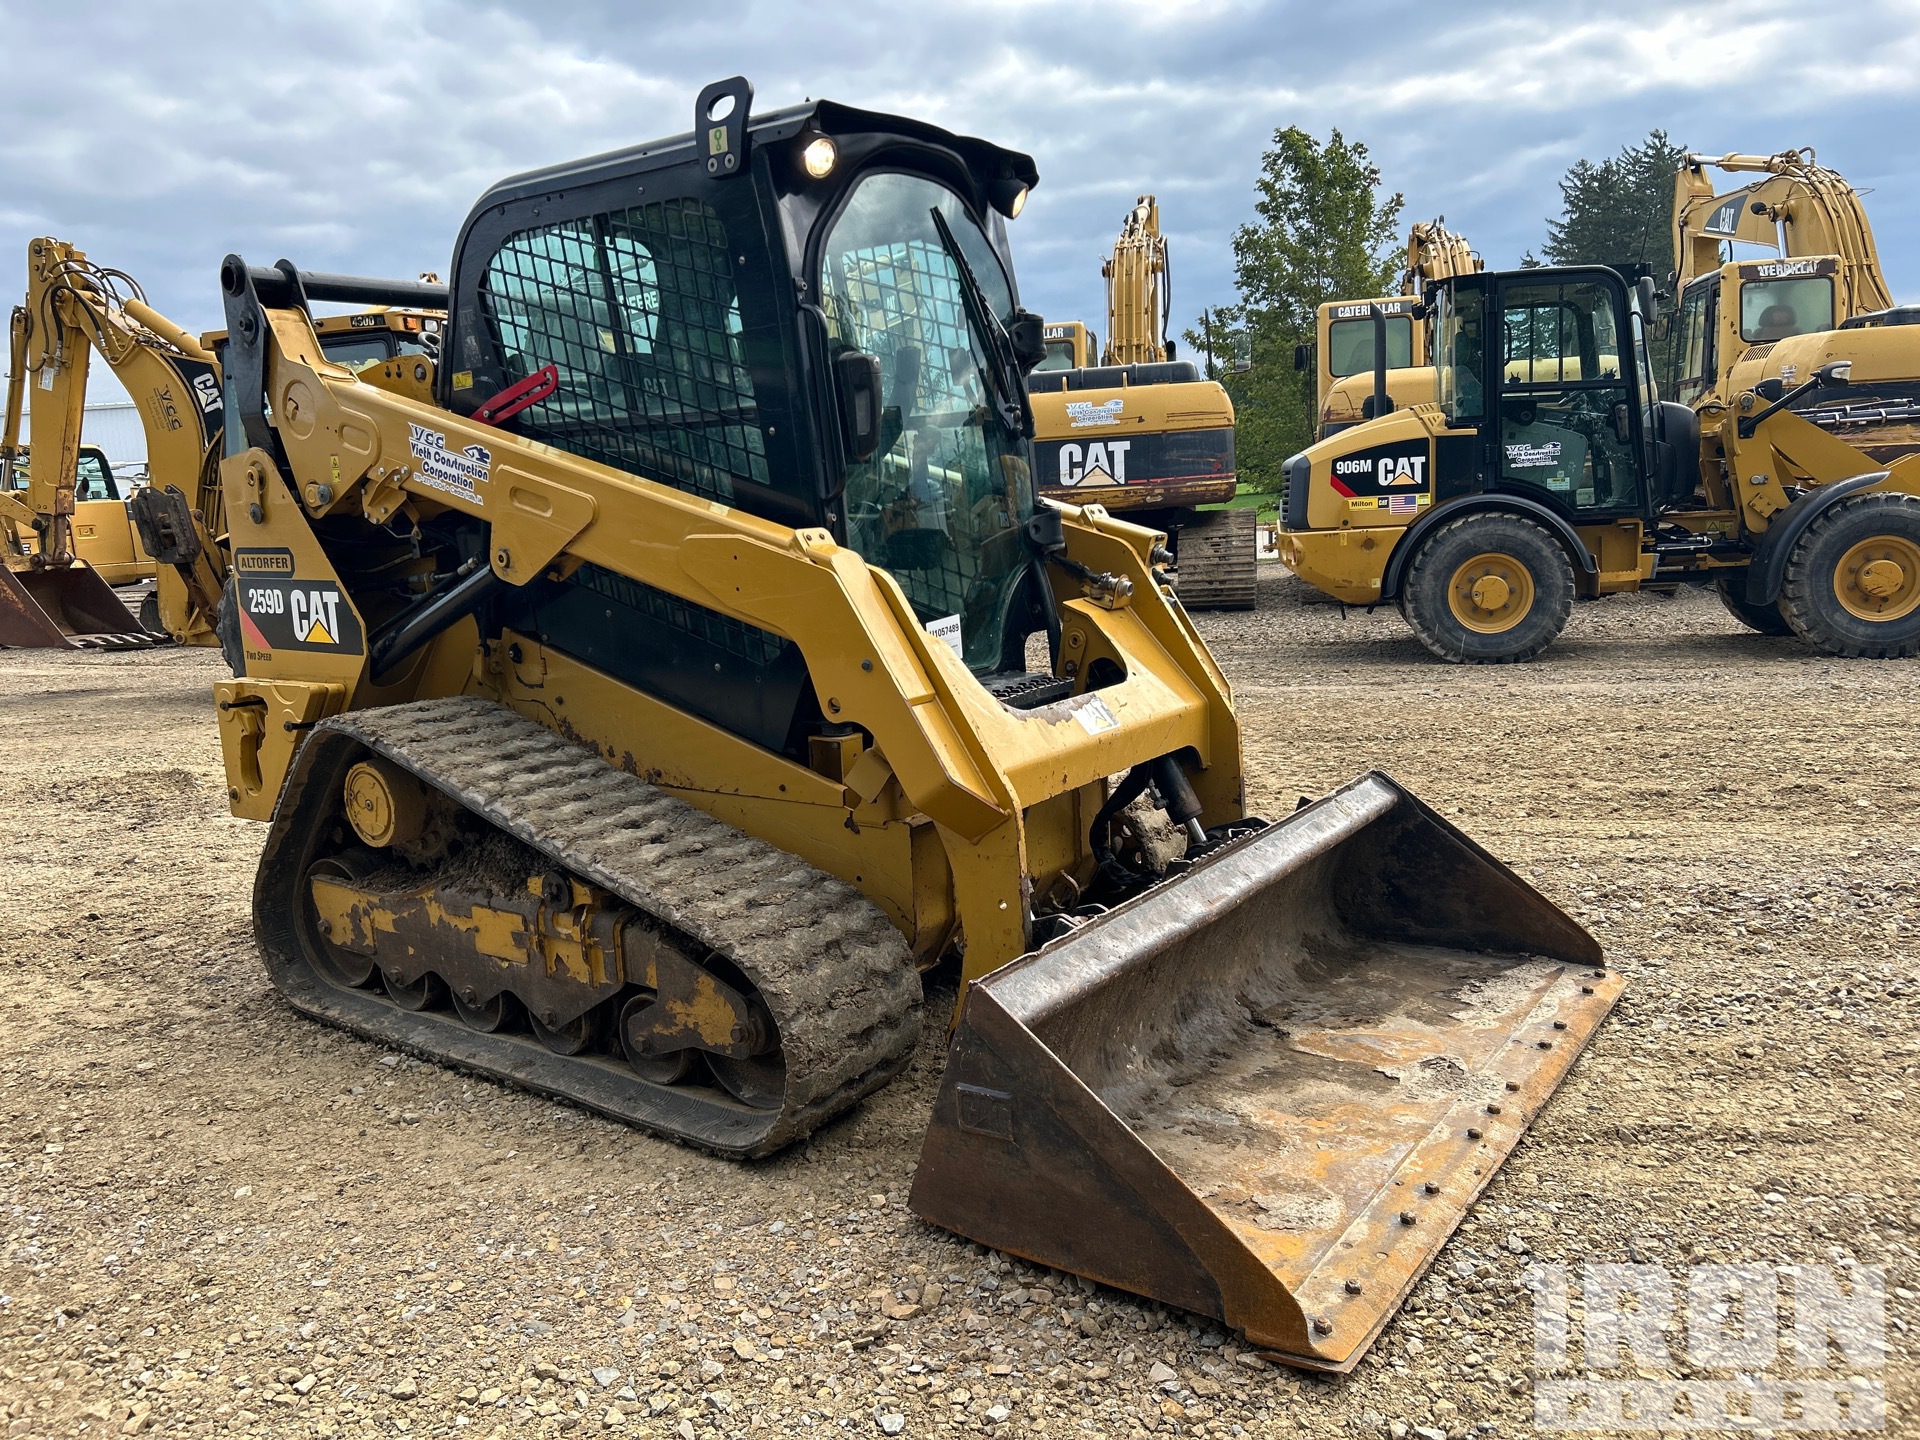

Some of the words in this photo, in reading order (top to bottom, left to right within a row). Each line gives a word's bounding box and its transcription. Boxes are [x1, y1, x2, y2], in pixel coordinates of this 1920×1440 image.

[1720, 207, 1735, 232] CAT
[161, 384, 183, 430] VCC
[193, 373, 224, 413] CAT
[411, 424, 444, 449] VCC
[411, 443, 432, 460] Vieth
[434, 451, 488, 480] Construction
[423, 461, 473, 489] Corporation
[1059, 441, 1131, 487] CAT
[1336, 459, 1372, 474] 906M
[1378, 456, 1426, 486] CAT
[1351, 500, 1373, 508] Milton
[241, 557, 289, 569] ALTORFER
[248, 588, 284, 614] 259D
[290, 589, 339, 644] CAT
